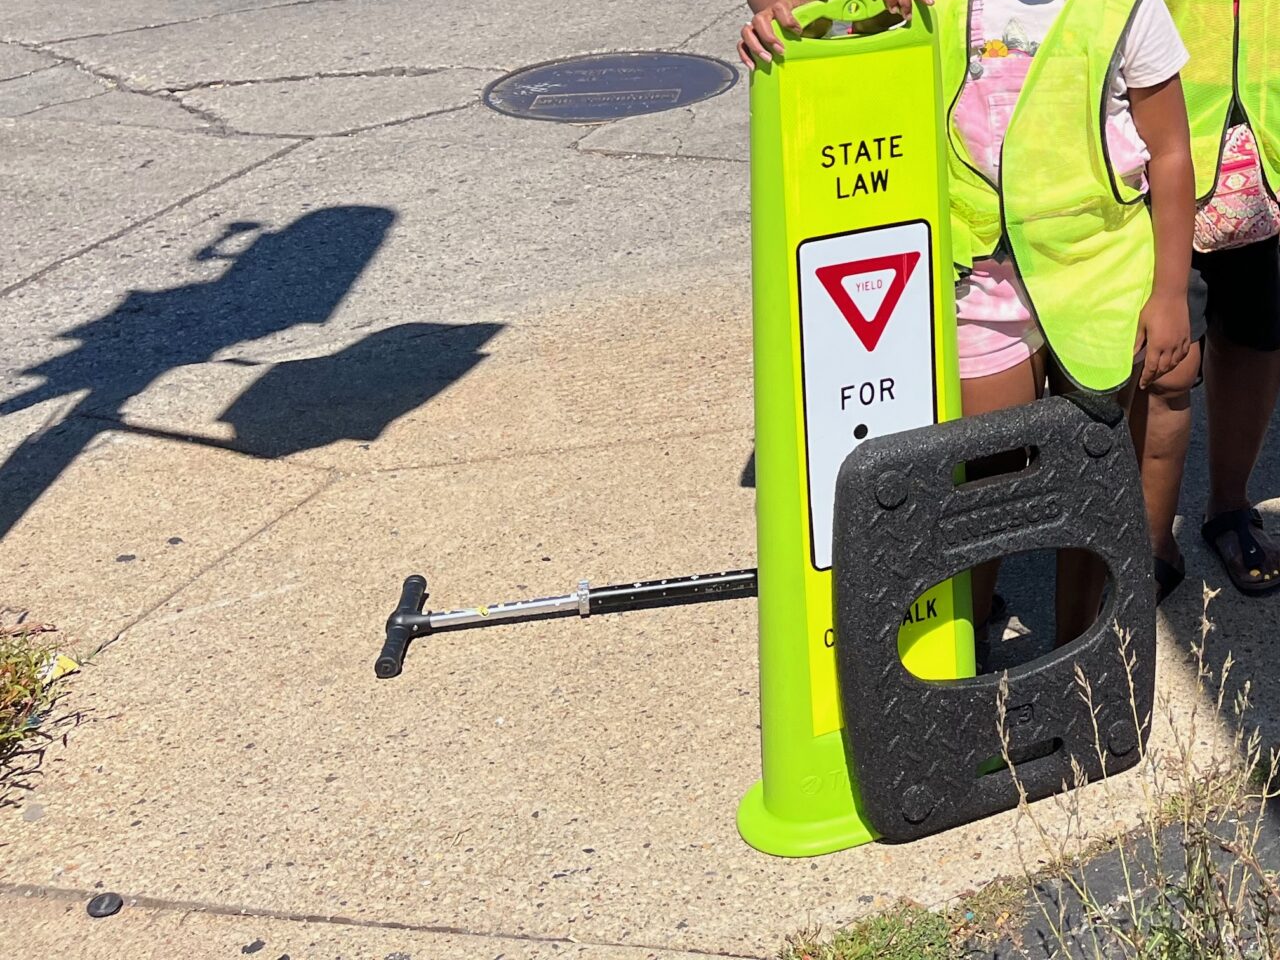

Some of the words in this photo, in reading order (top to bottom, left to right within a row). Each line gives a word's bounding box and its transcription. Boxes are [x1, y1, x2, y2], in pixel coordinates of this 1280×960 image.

[821, 135, 903, 168] STATE
[836, 169, 889, 199] LAW
[855, 279, 883, 292] YIELD
[840, 377, 895, 410] FOR
